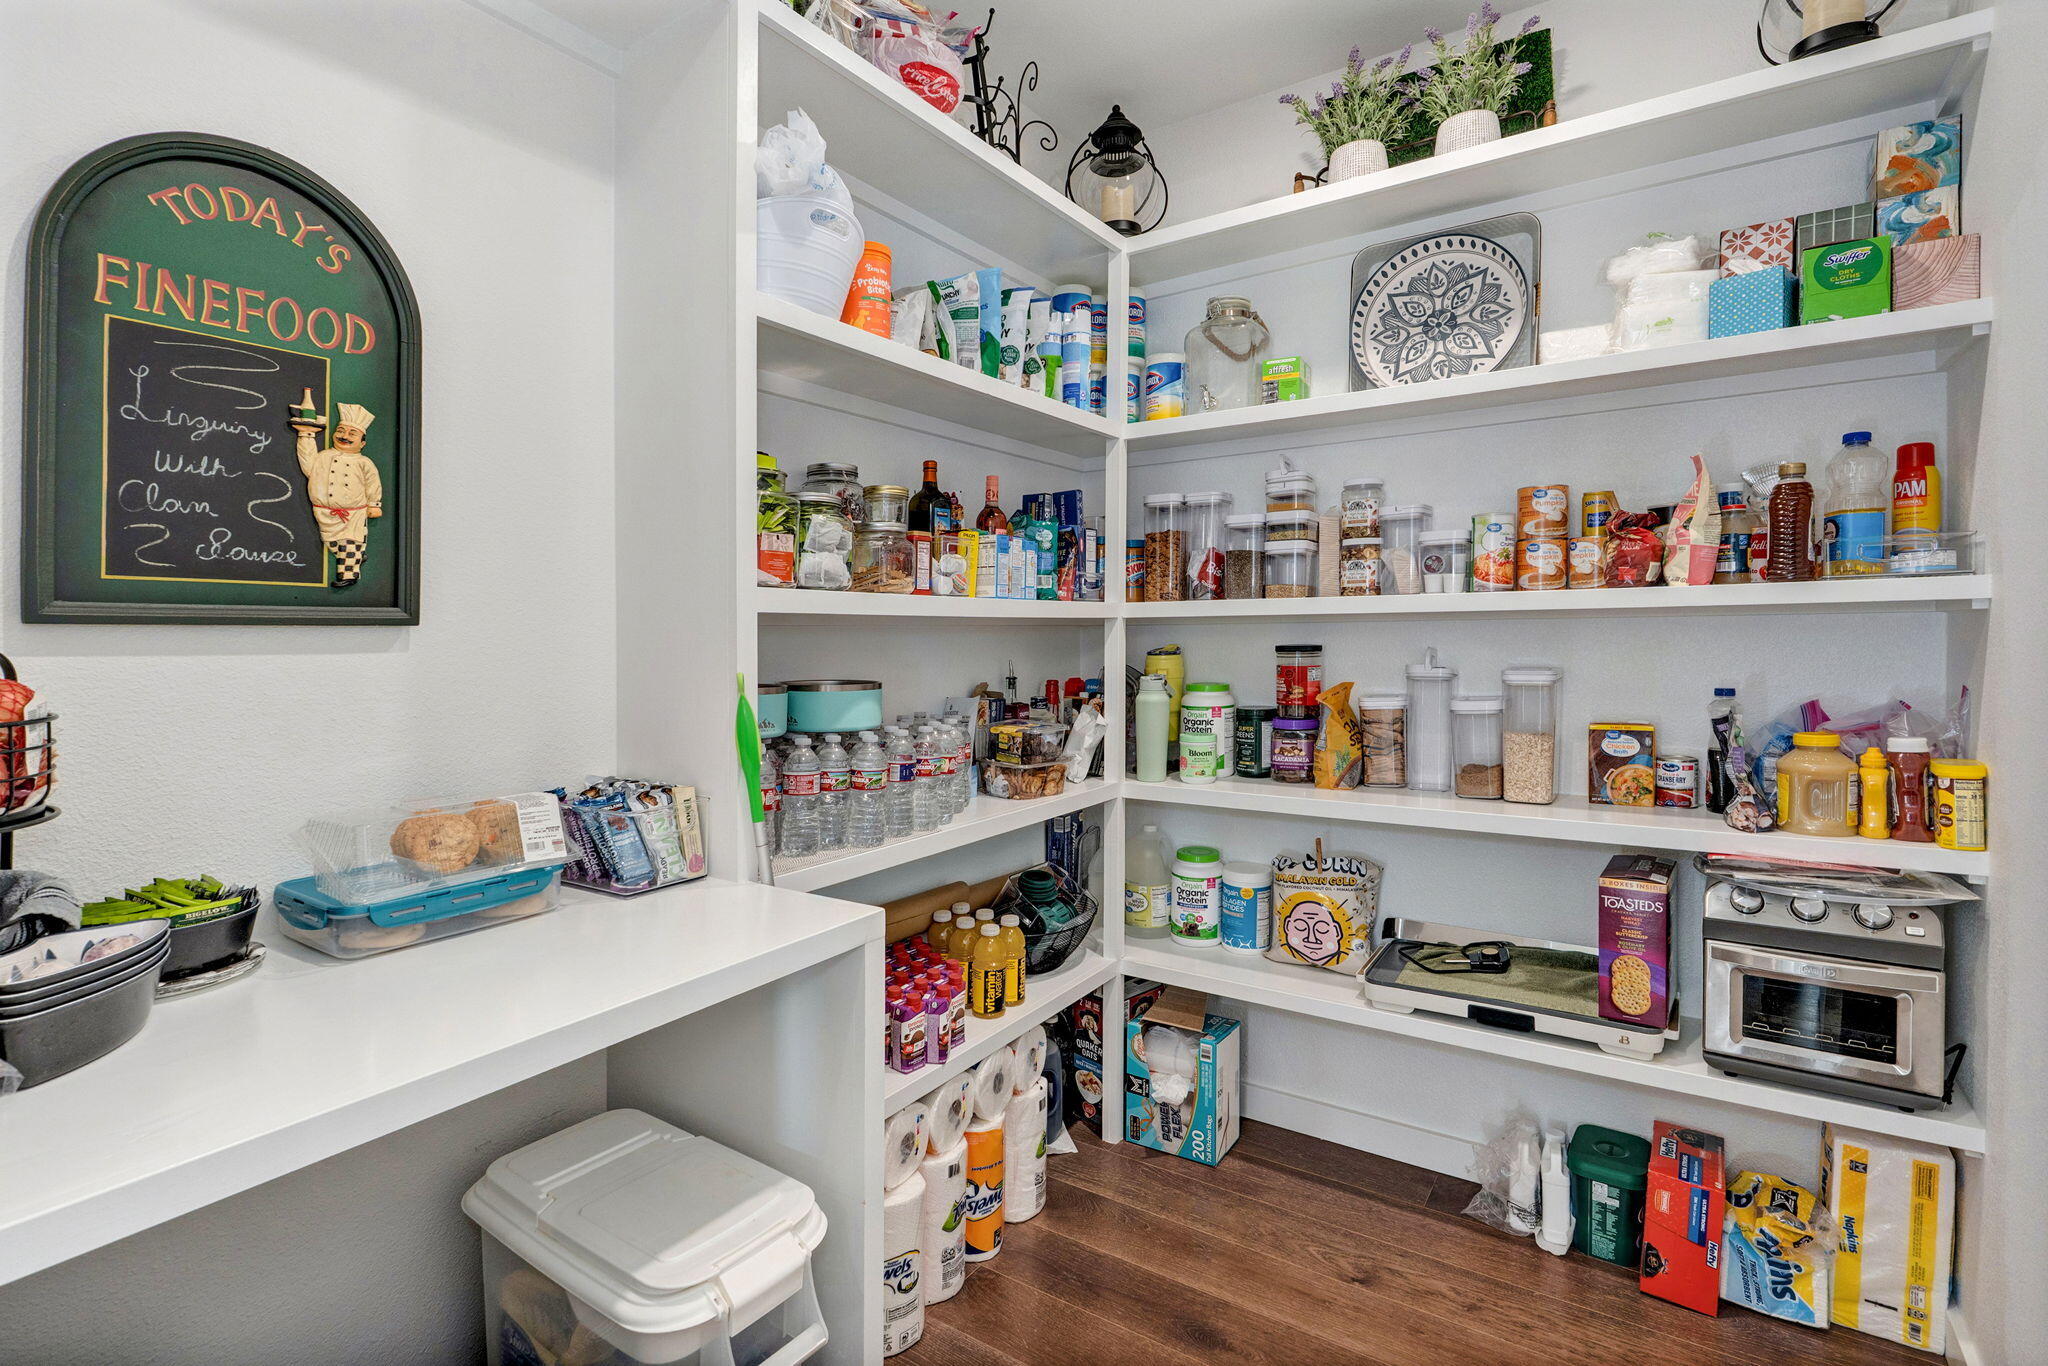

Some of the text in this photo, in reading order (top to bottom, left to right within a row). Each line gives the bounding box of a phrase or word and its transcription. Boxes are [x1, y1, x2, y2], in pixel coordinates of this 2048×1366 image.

[147, 183, 351, 275] TODAY'S
[1824, 249, 1871, 266] Swiffer
[1829, 272, 1861, 282] CLOTHS
[94, 252, 376, 356] FINEFOOD
[154, 450, 243, 479] With
[1894, 479, 1927, 499] PAM
[1534, 499, 1565, 508] Pumpkin
[1528, 553, 1560, 561] Pumpkin
[1183, 717, 1215, 727] Organic
[1187, 711, 1208, 719] Orgain
[1184, 725, 1213, 734] Protein
[1188, 749, 1213, 757] Bloom
[1181, 881, 1203, 891] Orgain
[1328, 876, 1357, 887] GOLD
[1609, 880, 1634, 888] BOXES
[1177, 886, 1209, 900] Organic
[1178, 894, 1208, 905] Protein
[1601, 895, 1664, 913] TOASTEDS
[185, 907, 229, 920] BIGELOW
[985, 971, 996, 1013] vitamin
[995, 971, 1003, 999] water
[1076, 1038, 1103, 1057] QUAKER
[1081, 1047, 1098, 1061] OATS
[1171, 1106, 1184, 1143] FLEX
[1207, 1114, 1216, 1129] Bags
[1192, 1130, 1206, 1161] 200
[1205, 1129, 1215, 1152] Kitchen
[1843, 1215, 1858, 1255] Napkins
[1707, 1241, 1718, 1268] Hefty
[884, 1257, 912, 1281] wels
[1741, 1264, 1753, 1303] ABSORBENT
